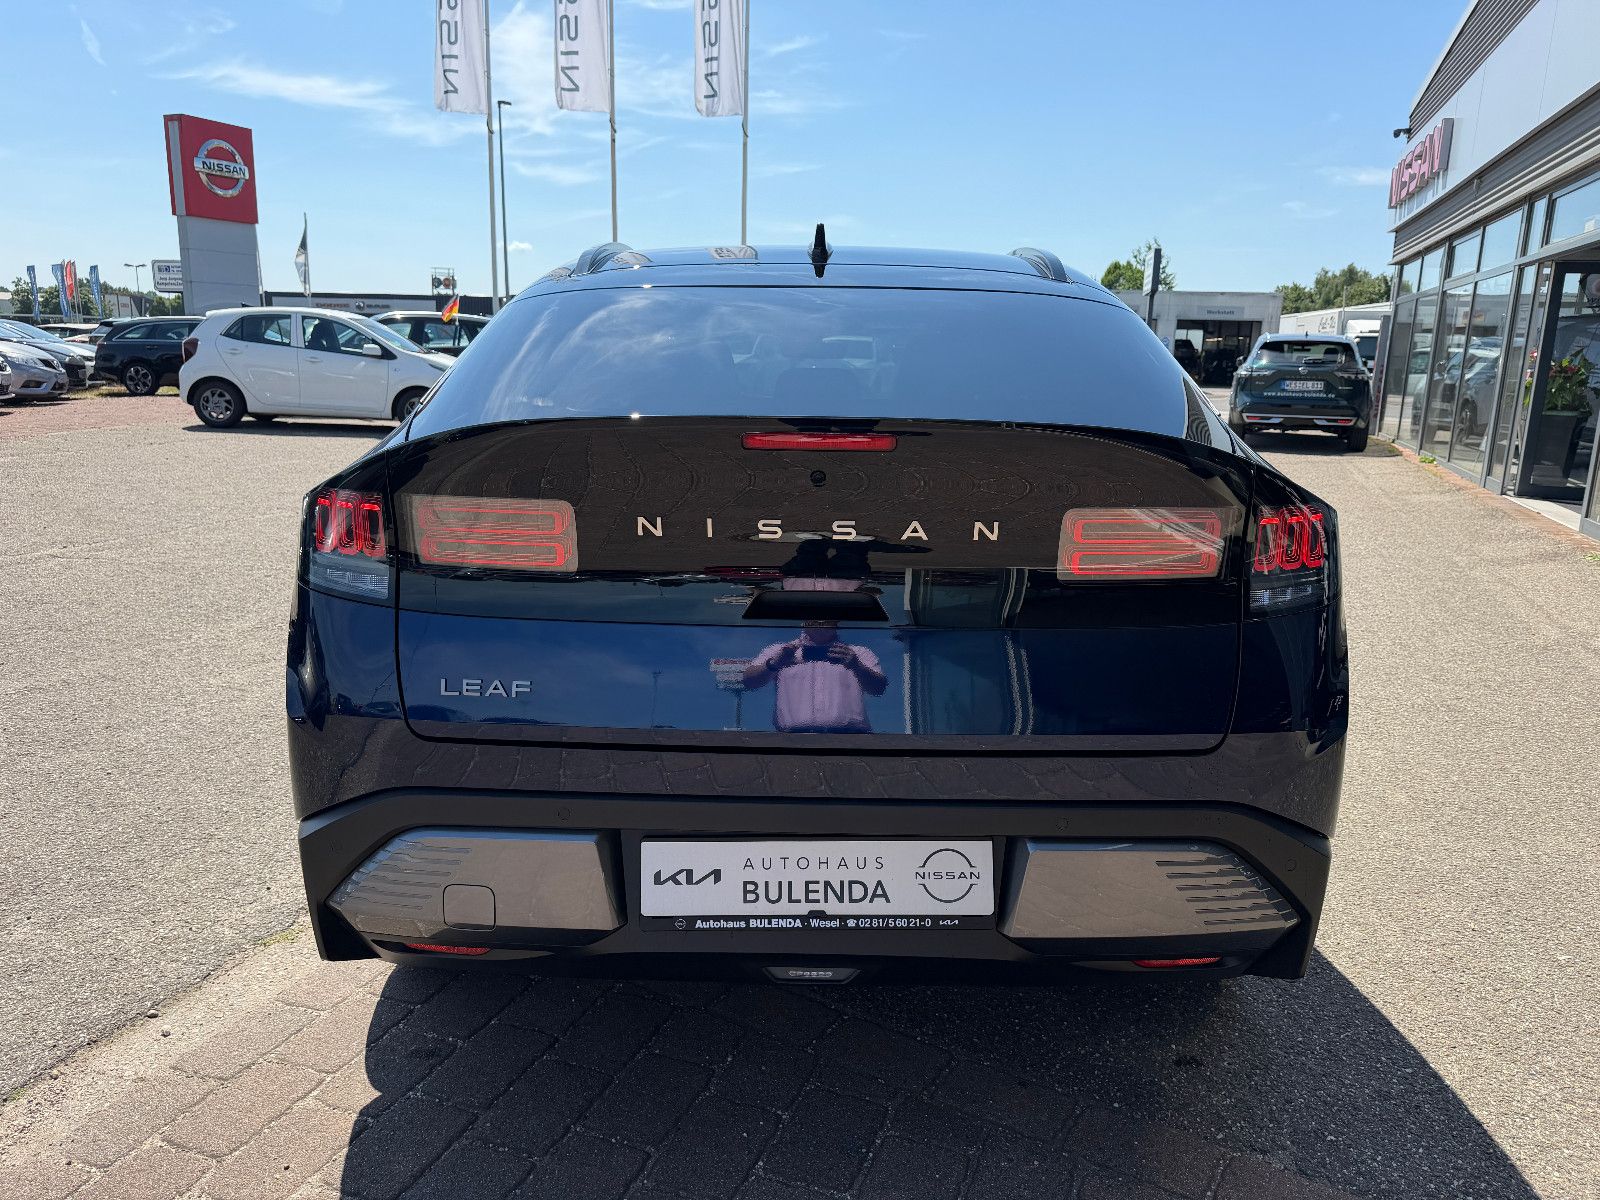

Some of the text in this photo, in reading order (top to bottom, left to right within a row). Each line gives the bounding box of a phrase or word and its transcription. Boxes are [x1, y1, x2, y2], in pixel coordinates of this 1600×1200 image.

[201, 160, 246, 177] NISSAN
[1388, 118, 1454, 209] NISSAN
[637, 516, 1000, 541] NISSAN
[440, 678, 533, 698] LEAF
[743, 856, 885, 870] AUTOHAUS
[915, 870, 981, 880] NISSAN
[742, 879, 891, 904] BULENDA
[695, 919, 746, 929] Autohaus
[749, 918, 803, 928] BULENDA
[810, 918, 840, 928] Wesel
